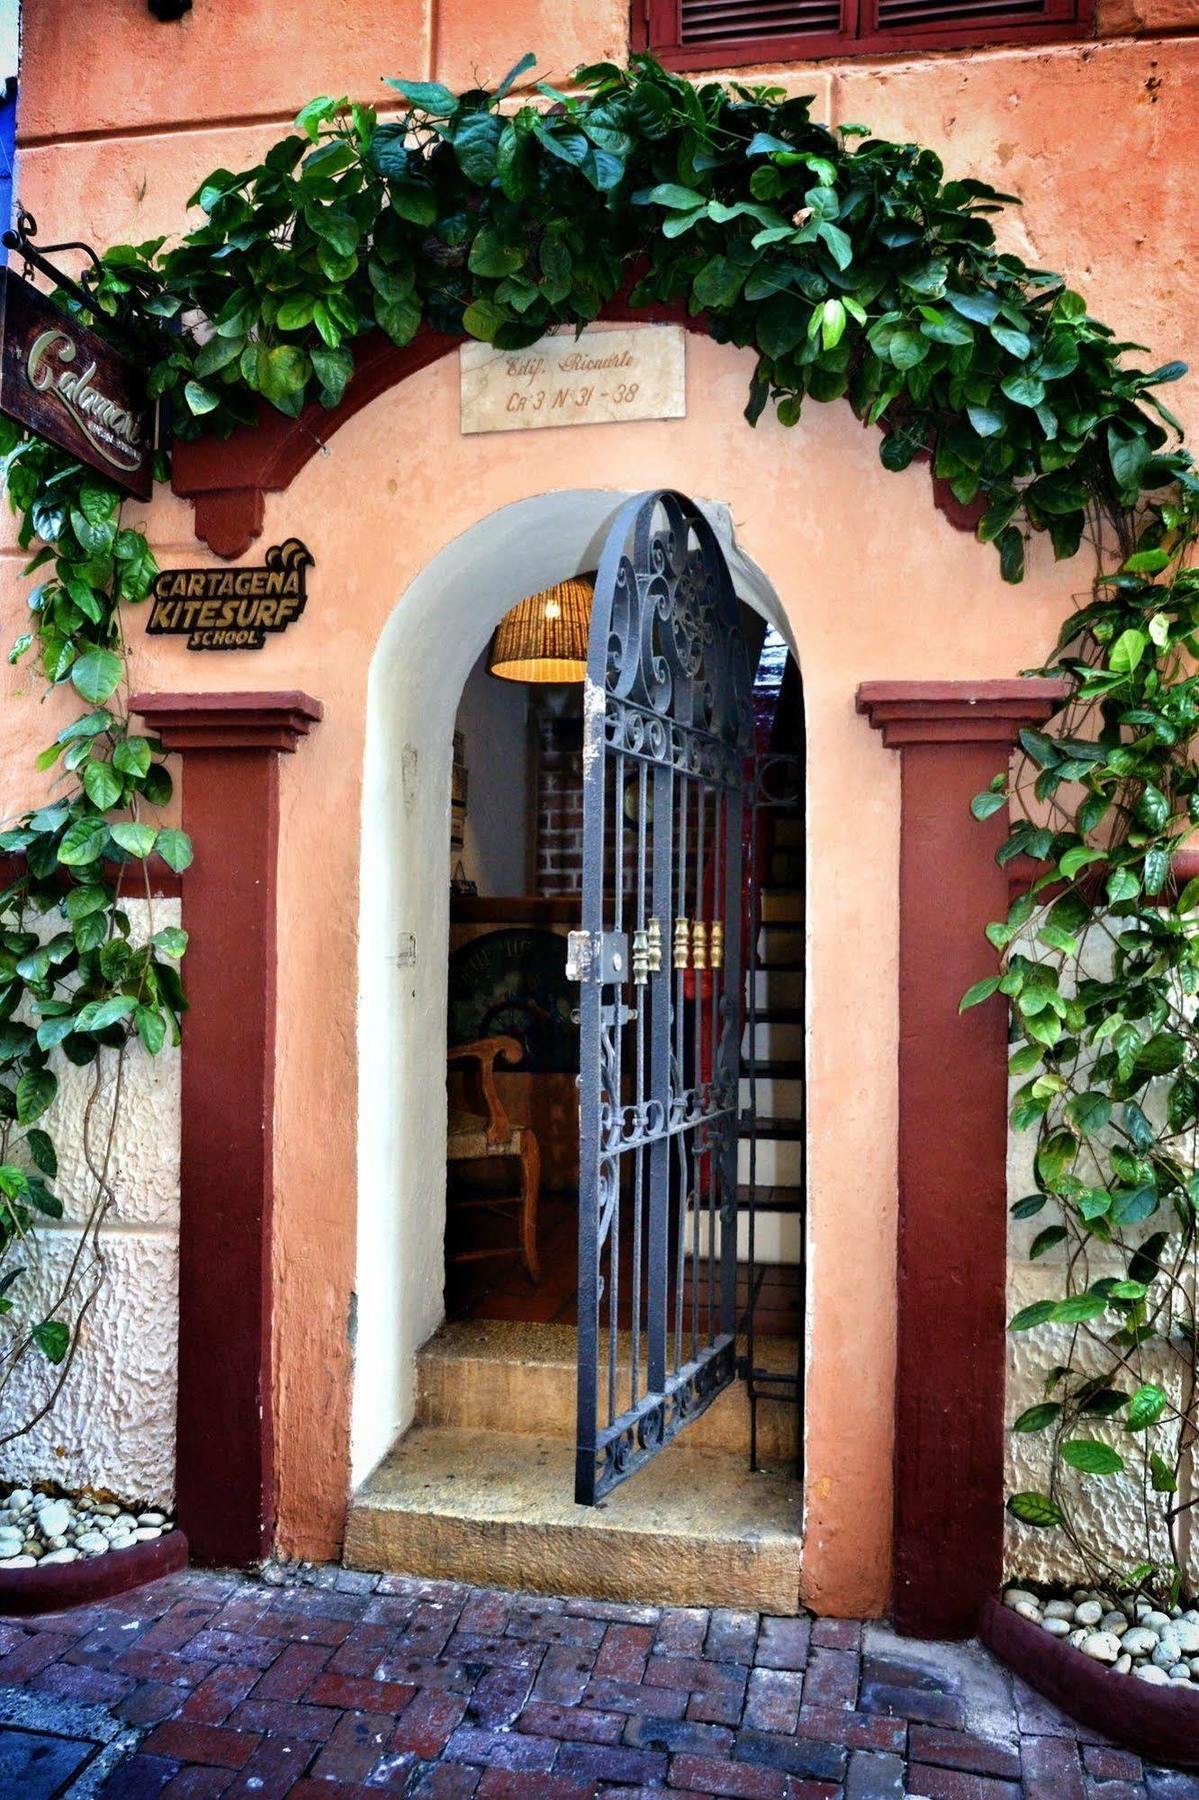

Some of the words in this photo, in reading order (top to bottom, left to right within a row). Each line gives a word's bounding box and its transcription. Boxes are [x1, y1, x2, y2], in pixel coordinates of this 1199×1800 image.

[533, 390, 545, 410] 3
[575, 385, 595, 406] 31
[613, 383, 640, 404] 38
[156, 571, 300, 597] CARTAGENA
[150, 599, 300, 628] KITESURF
[190, 630, 259, 646] SCHOOL
